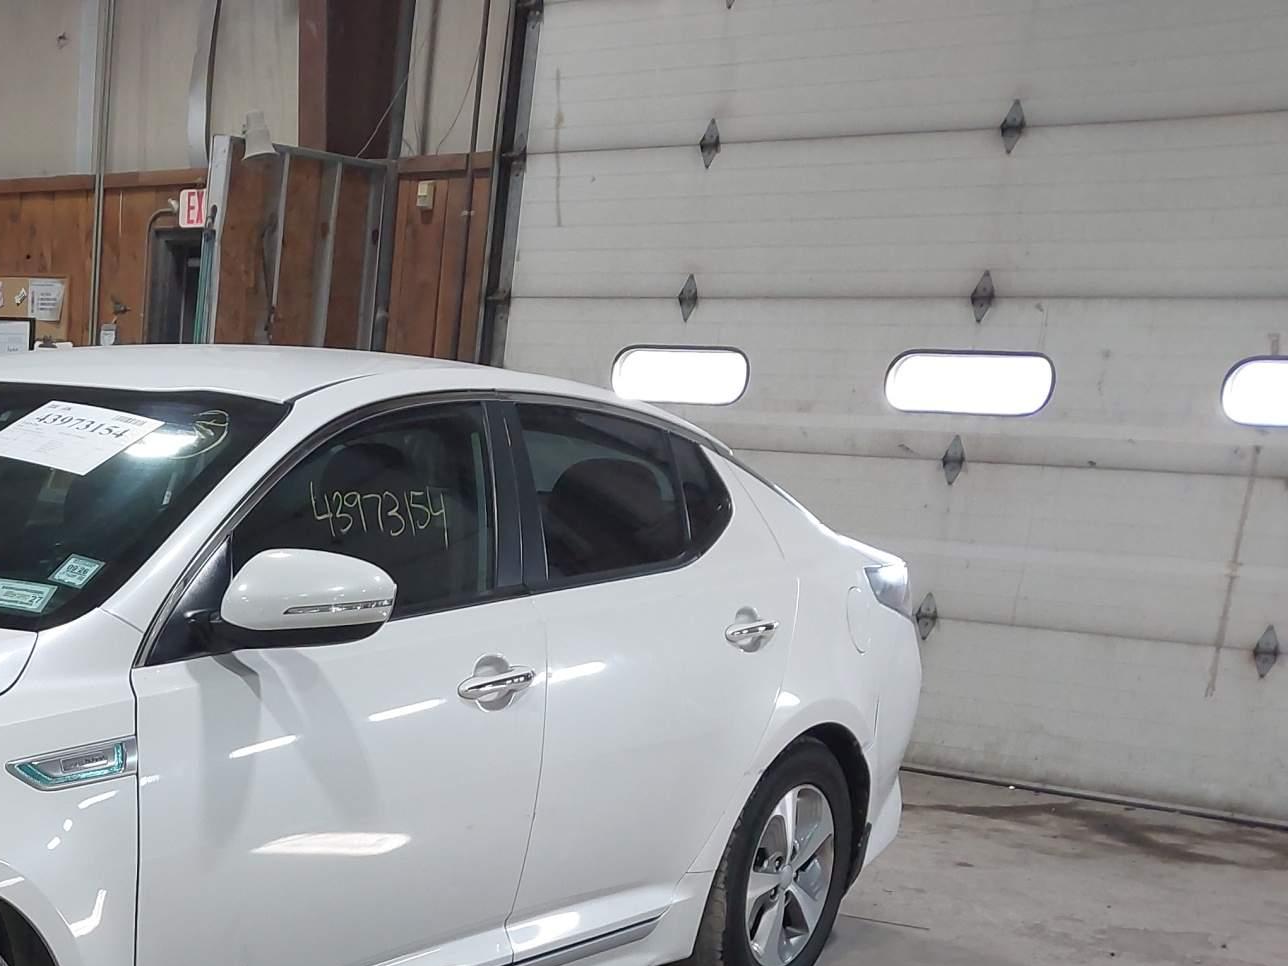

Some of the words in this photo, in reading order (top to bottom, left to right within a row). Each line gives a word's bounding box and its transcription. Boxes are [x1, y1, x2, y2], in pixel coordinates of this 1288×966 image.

[187, 191, 205, 225] EX
[35, 413, 130, 438] 43973154
[310, 481, 449, 550] 43973154
